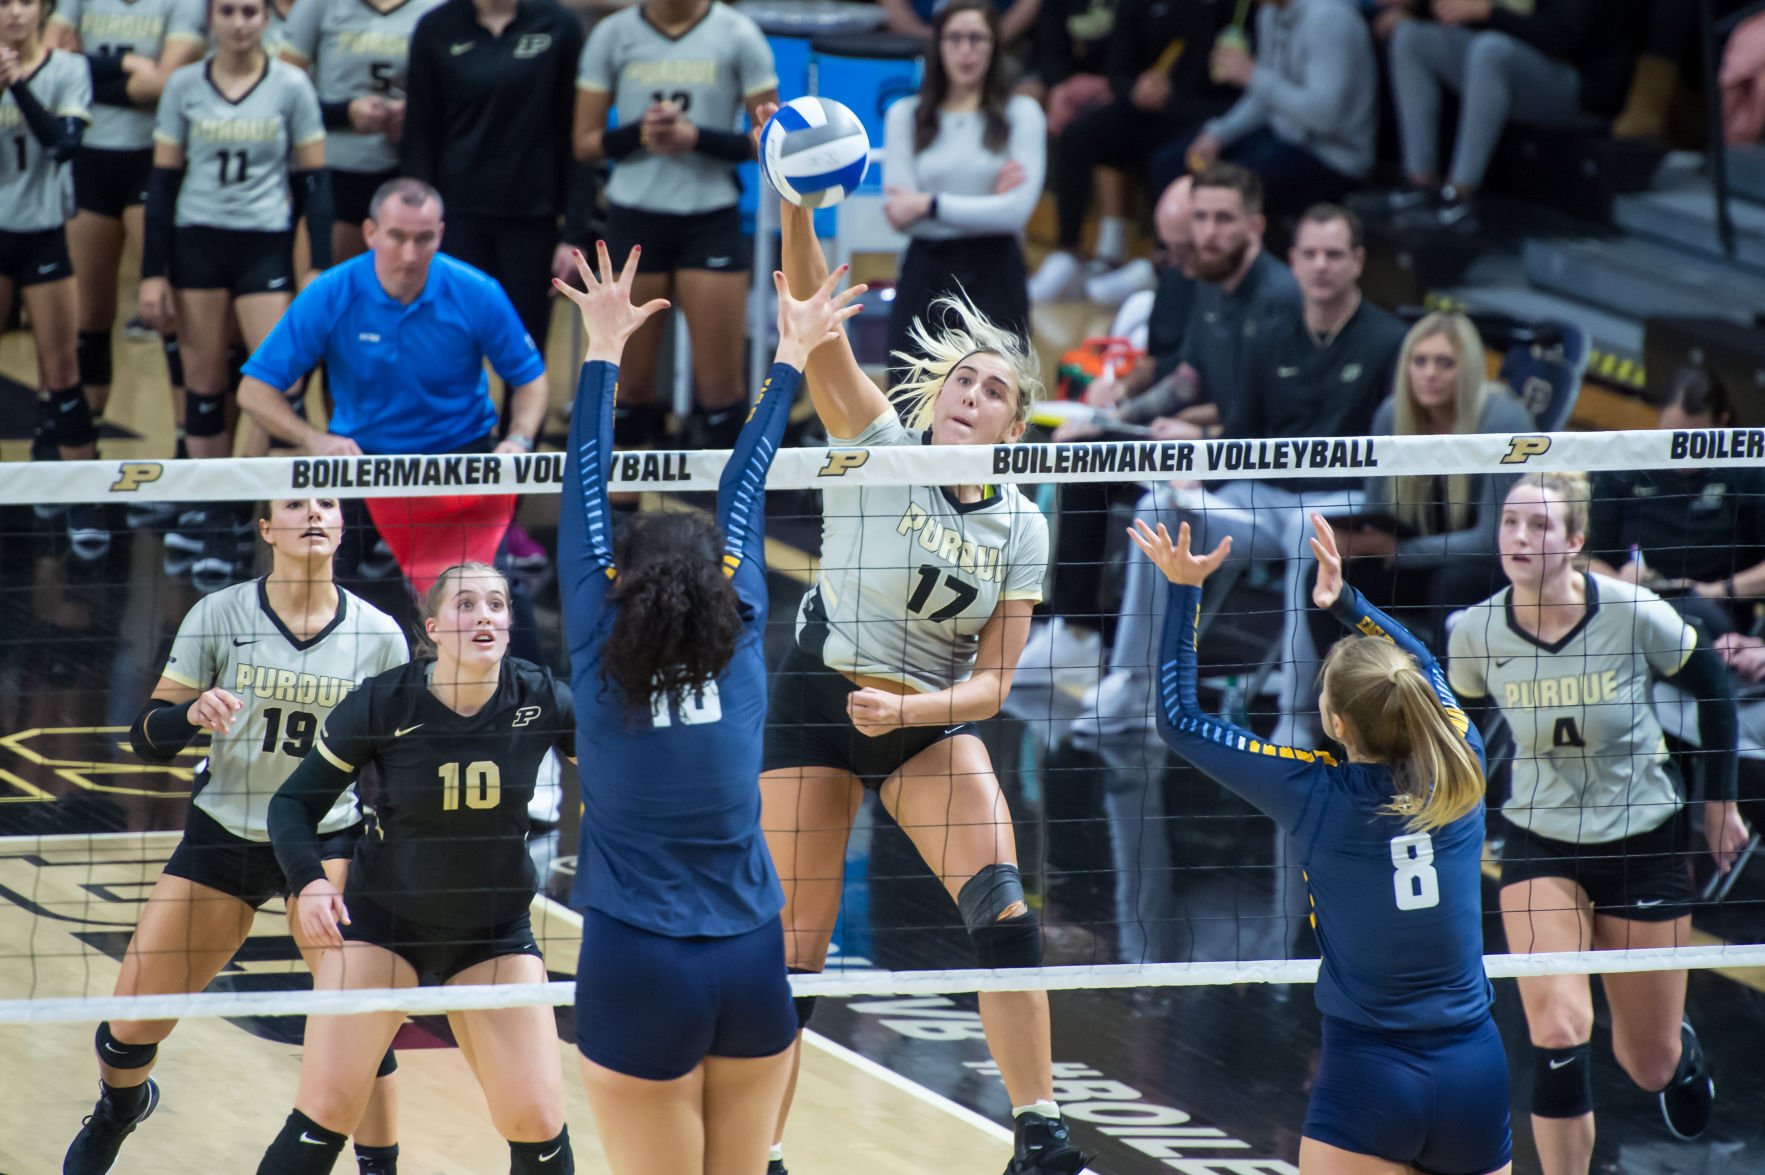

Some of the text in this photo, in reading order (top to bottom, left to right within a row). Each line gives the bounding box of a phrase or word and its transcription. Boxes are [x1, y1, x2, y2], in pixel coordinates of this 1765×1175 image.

[371, 63, 396, 93] 5
[217, 148, 248, 186] 11
[109, 462, 163, 492] P
[291, 456, 501, 488] BOILERMAKER
[817, 448, 870, 477] P
[992, 443, 1195, 474] BOILERMAKER
[1206, 439, 1378, 471] VOLLEYBALL
[1500, 435, 1552, 464] P
[1671, 430, 1765, 459] BOILER
[907, 564, 979, 623] 17
[1504, 668, 1618, 711] PURDUE
[262, 707, 318, 758] 19
[511, 705, 541, 728] P
[1553, 716, 1586, 747] 4
[438, 760, 501, 811] 10
[1390, 831, 1440, 911] 8
